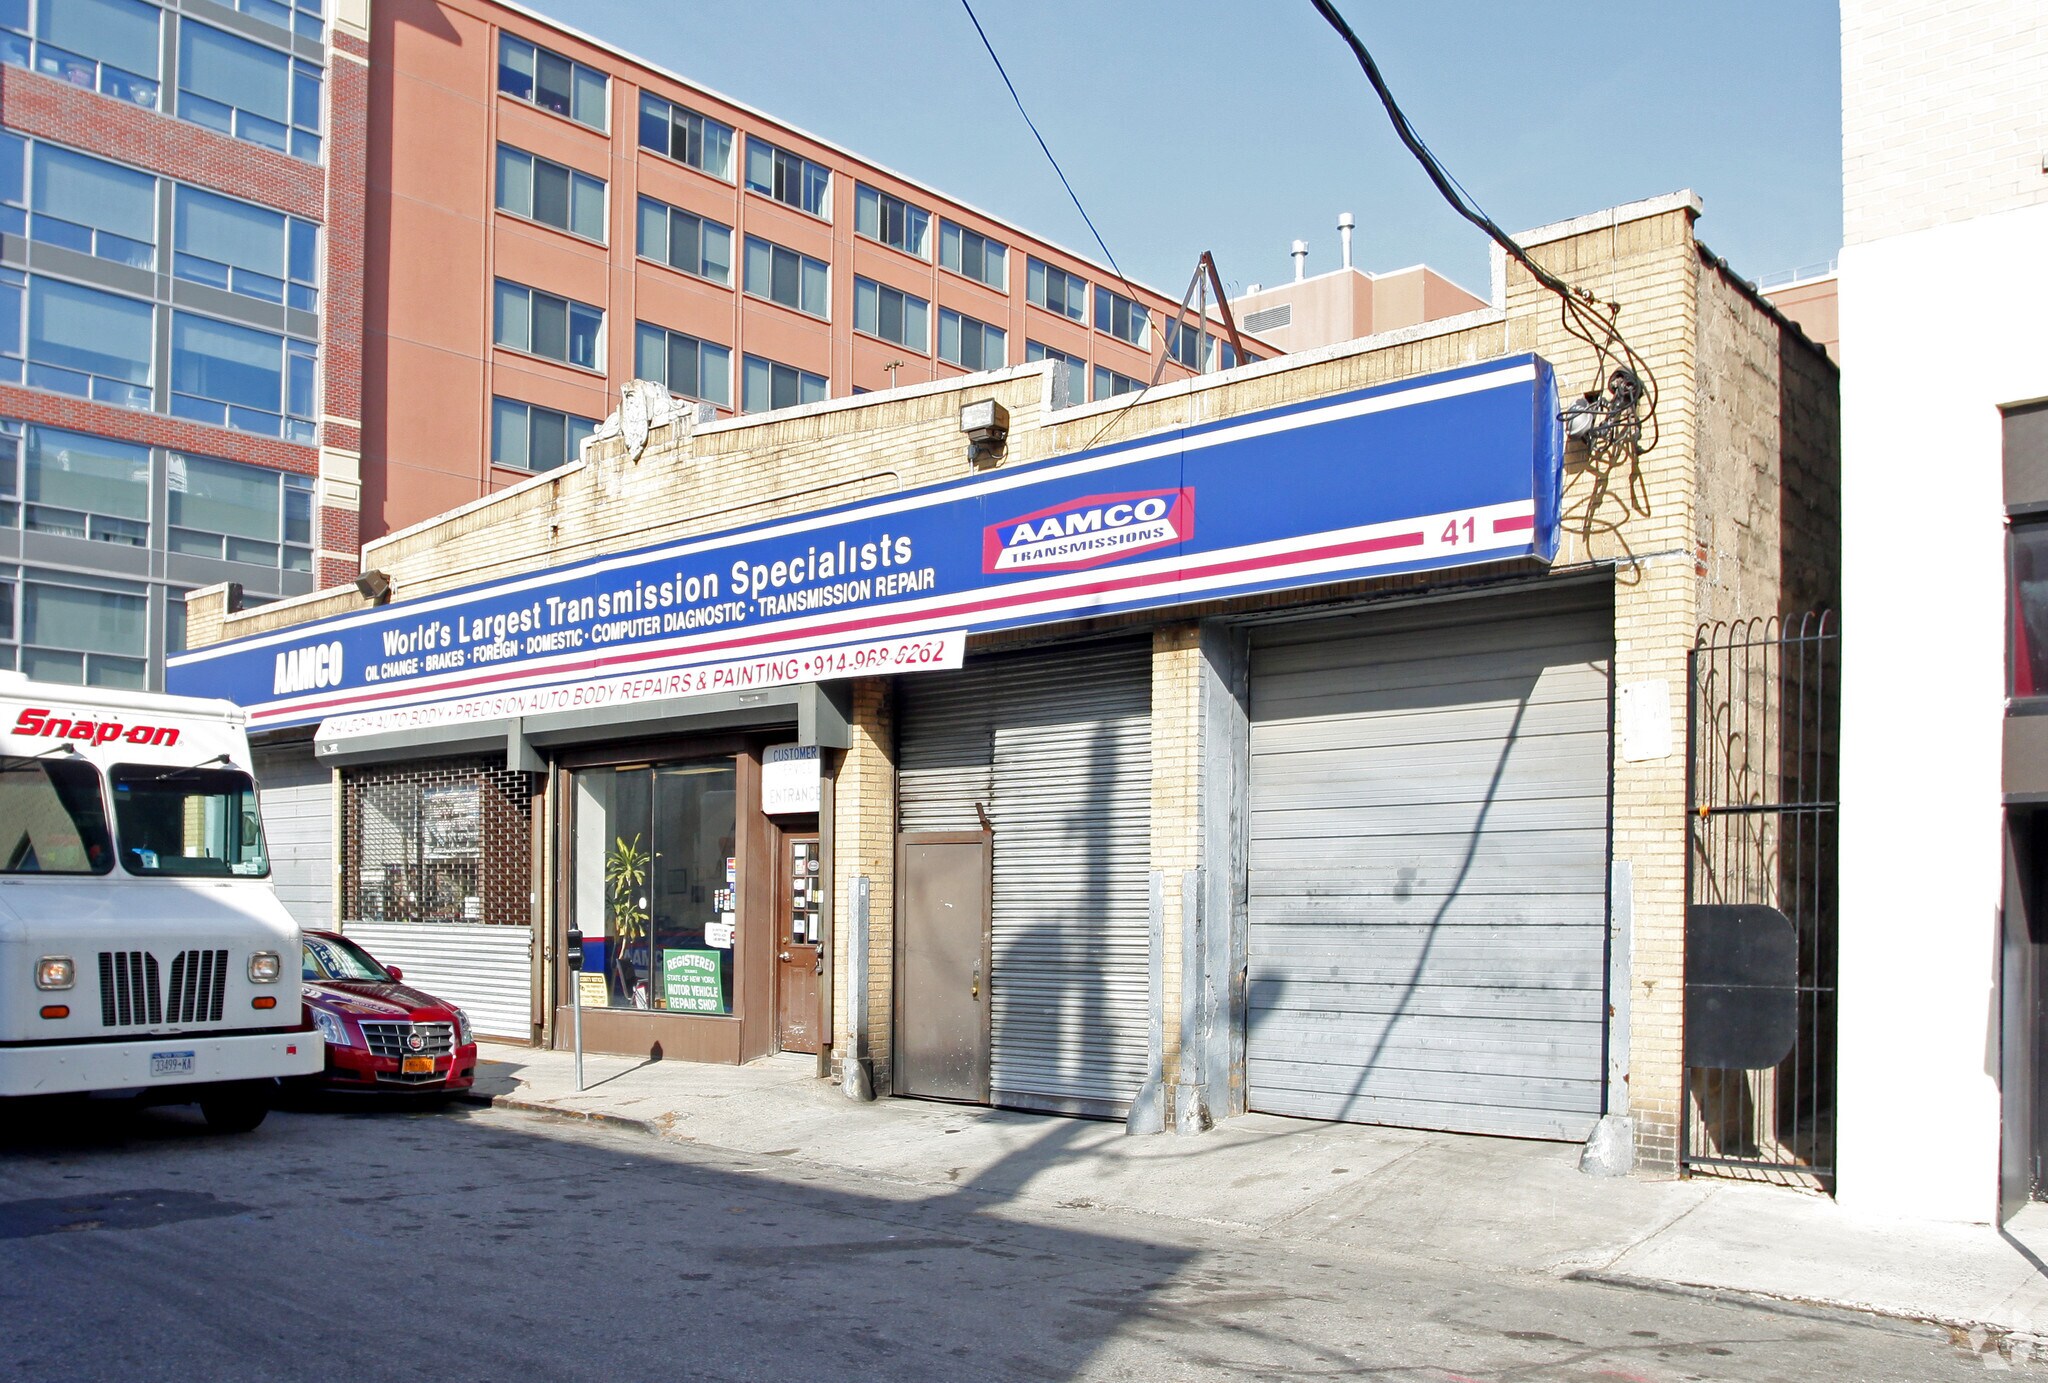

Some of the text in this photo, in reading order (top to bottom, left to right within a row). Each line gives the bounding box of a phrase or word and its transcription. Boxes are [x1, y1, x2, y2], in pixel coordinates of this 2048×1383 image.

[1008, 498, 1167, 546] AAMCO
[1441, 516, 1475, 546] 41
[1013, 526, 1165, 563] TRANSMISSIONS
[383, 534, 912, 657] World's Largest Transmission Specialists
[365, 567, 935, 682] OIL CHANGE BRAKES FOREIGN DOMESTIC COMPUTER DIAGNOSTIC TRANSMISSION REPAIR
[273, 641, 343, 695] AAMCO
[376, 711, 408, 729] AUTO
[410, 706, 445, 727] BODY
[456, 696, 527, 719] PRECISION
[530, 689, 569, 711] AUTO
[573, 684, 617, 705] BODY
[620, 673, 692, 700] REPAIRS
[696, 671, 706, 690] &
[712, 659, 799, 689] PAINTING
[11, 708, 180, 747] Snap-on
[773, 746, 817, 761] CUSTOMER
[666, 954, 715, 972] REGISTERED
[666, 974, 681, 982] STATE
[701, 976, 716, 984] YORK
[667, 984, 718, 998] MOTOR VEHICLE
[669, 997, 717, 1011] REPAIR SHOP
